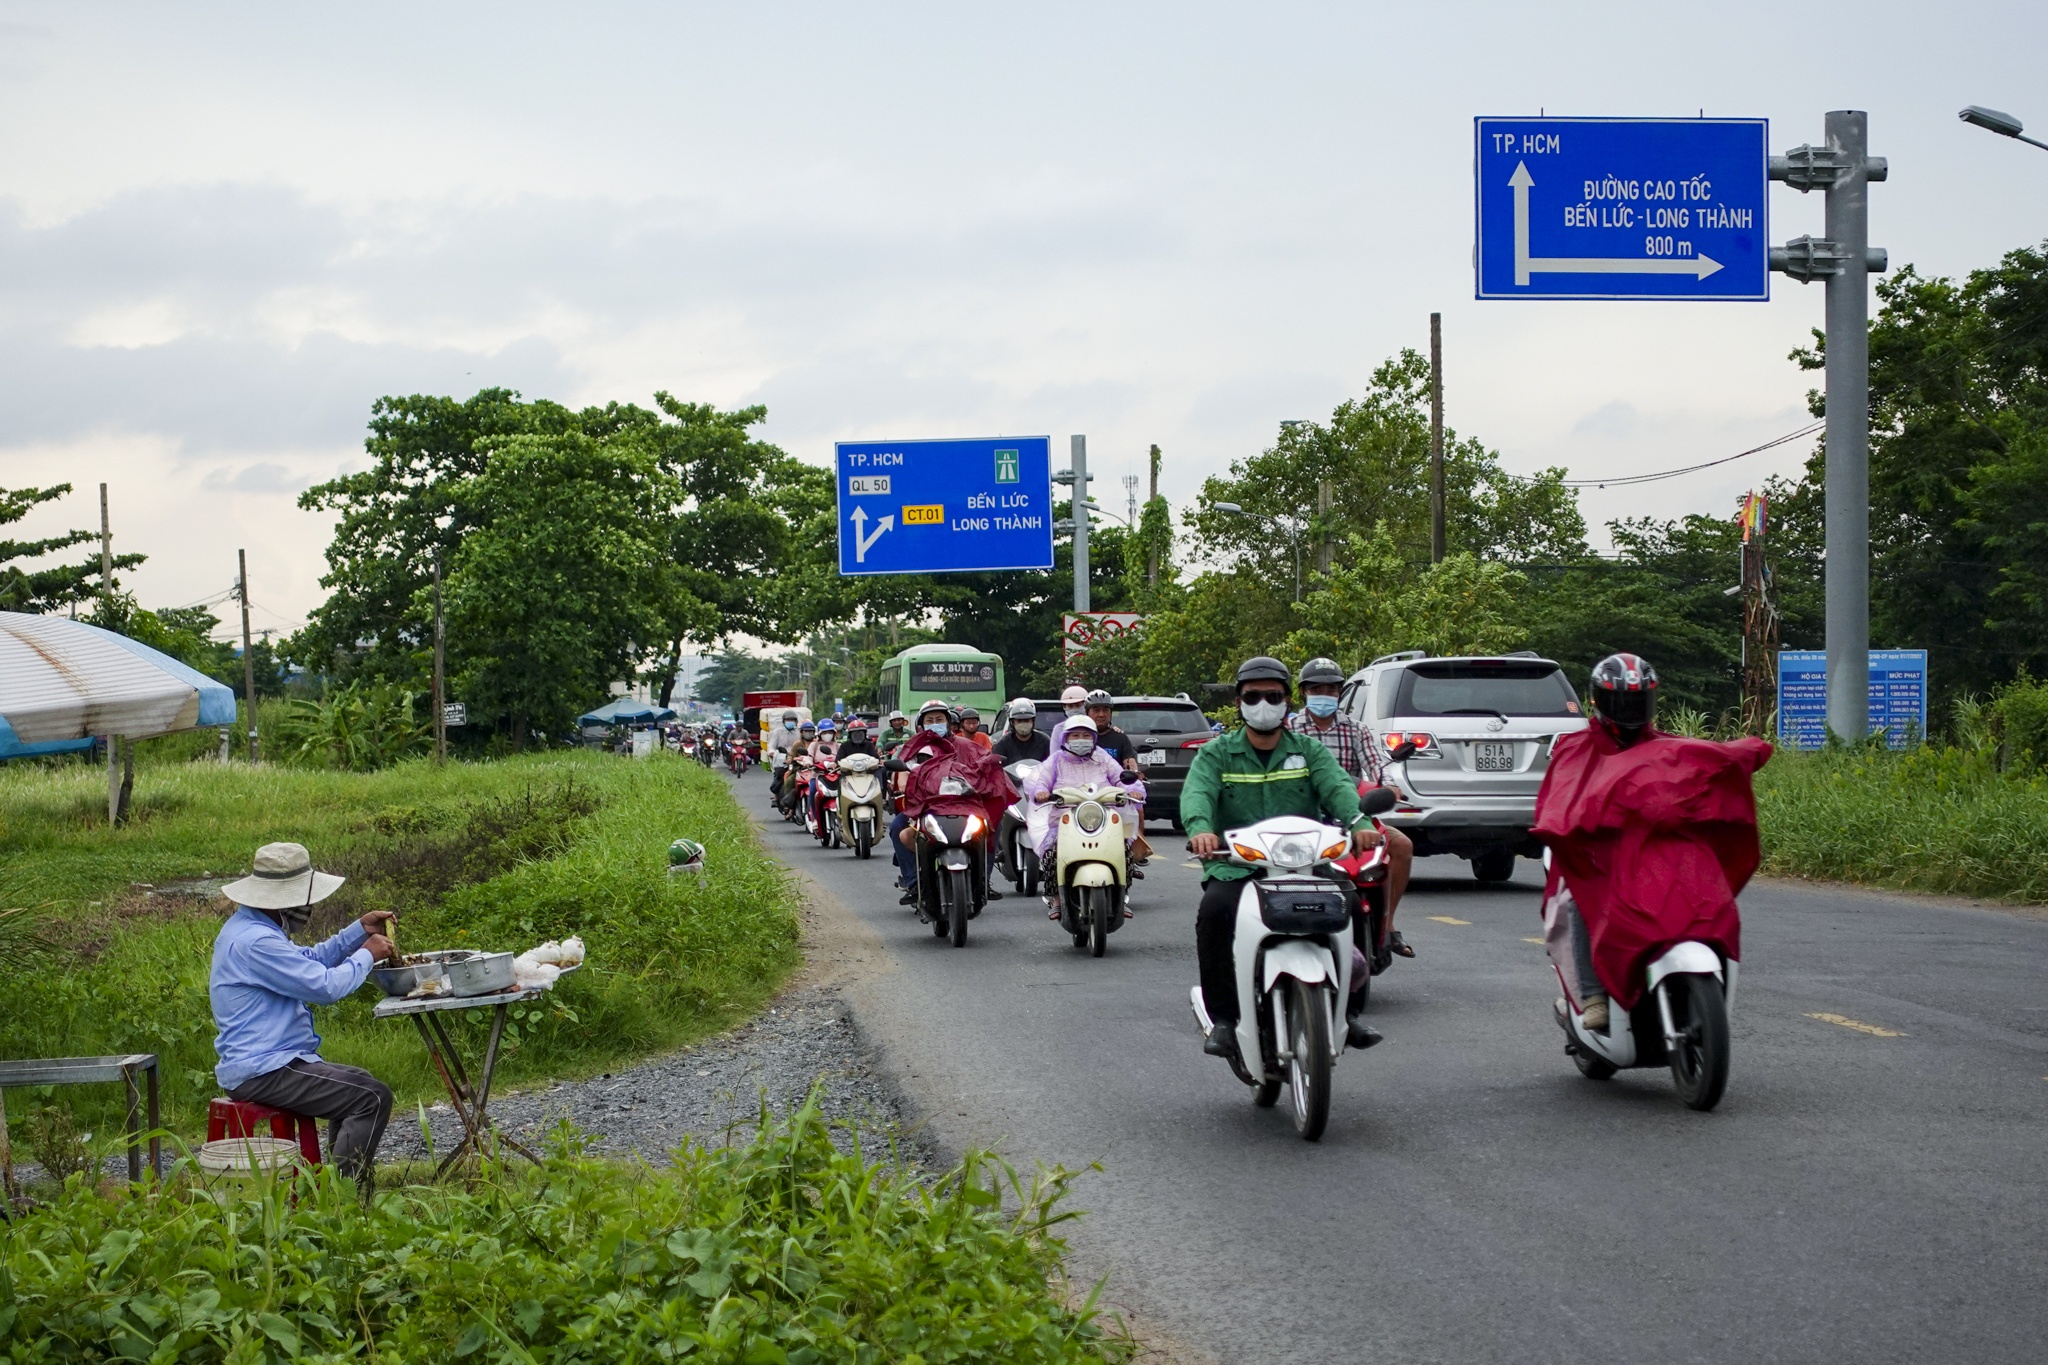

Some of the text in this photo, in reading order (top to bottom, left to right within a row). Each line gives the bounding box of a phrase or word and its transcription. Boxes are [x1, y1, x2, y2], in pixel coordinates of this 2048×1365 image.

[1523, 134, 1560, 154] HCM
[1584, 173, 1711, 200] ĐƯỜNG CAO TỐC
[1564, 202, 1598, 227] BẾN
[1696, 203, 1752, 229] THÀNH
[1645, 236, 1692, 256] 800 m
[873, 452, 903, 466] HCM
[852, 479, 888, 492] QL 50
[967, 491, 1029, 509] BẾN LỨC
[907, 508, 939, 521] CT.01
[952, 513, 1042, 531] LONG THÀNH
[931, 661, 973, 672] XE BÚYT
[981, 670, 992, 678] 629
[1484, 745, 1505, 756] 51A
[1477, 757, 1513, 769] 886.98
